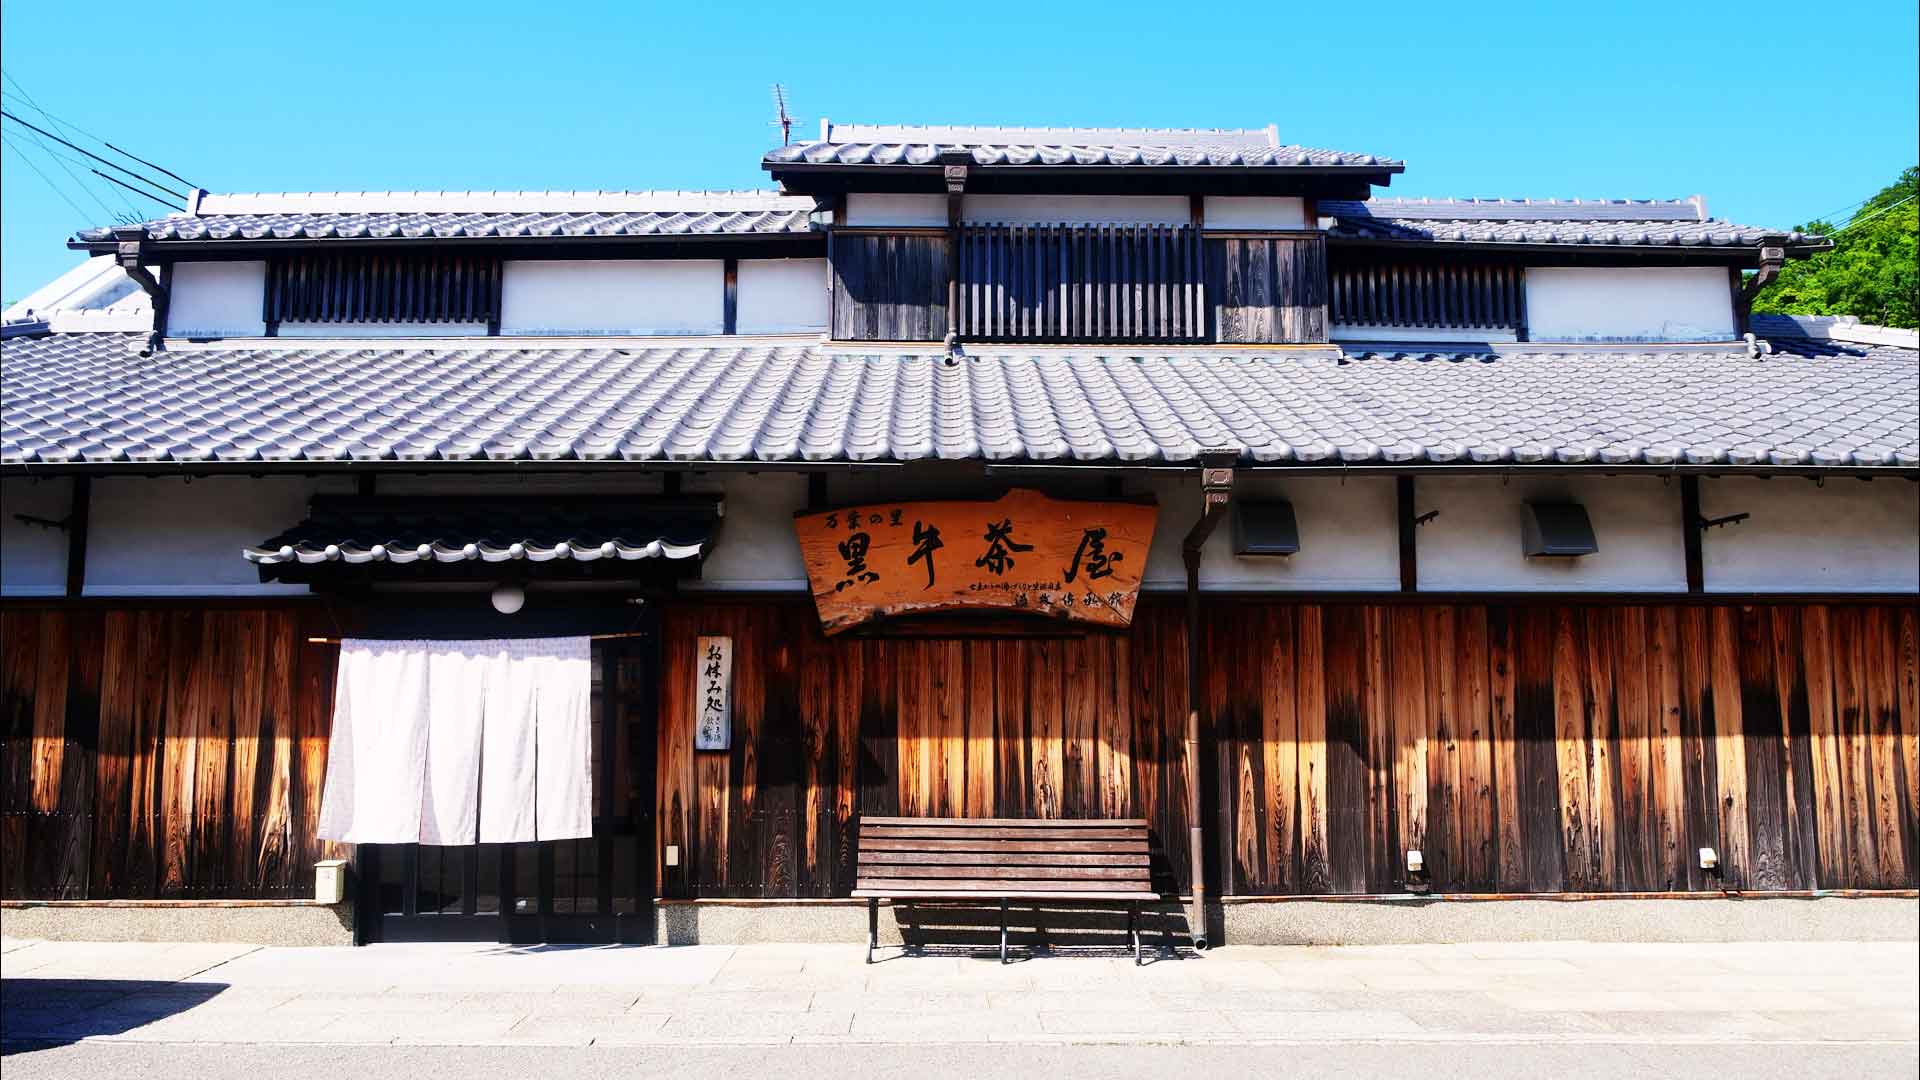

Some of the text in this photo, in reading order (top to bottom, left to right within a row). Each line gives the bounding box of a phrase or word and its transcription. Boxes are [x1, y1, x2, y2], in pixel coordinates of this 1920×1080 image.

[835, 519, 1124, 594] 黒牛茶屋
[704, 644, 724, 711] お休み処
